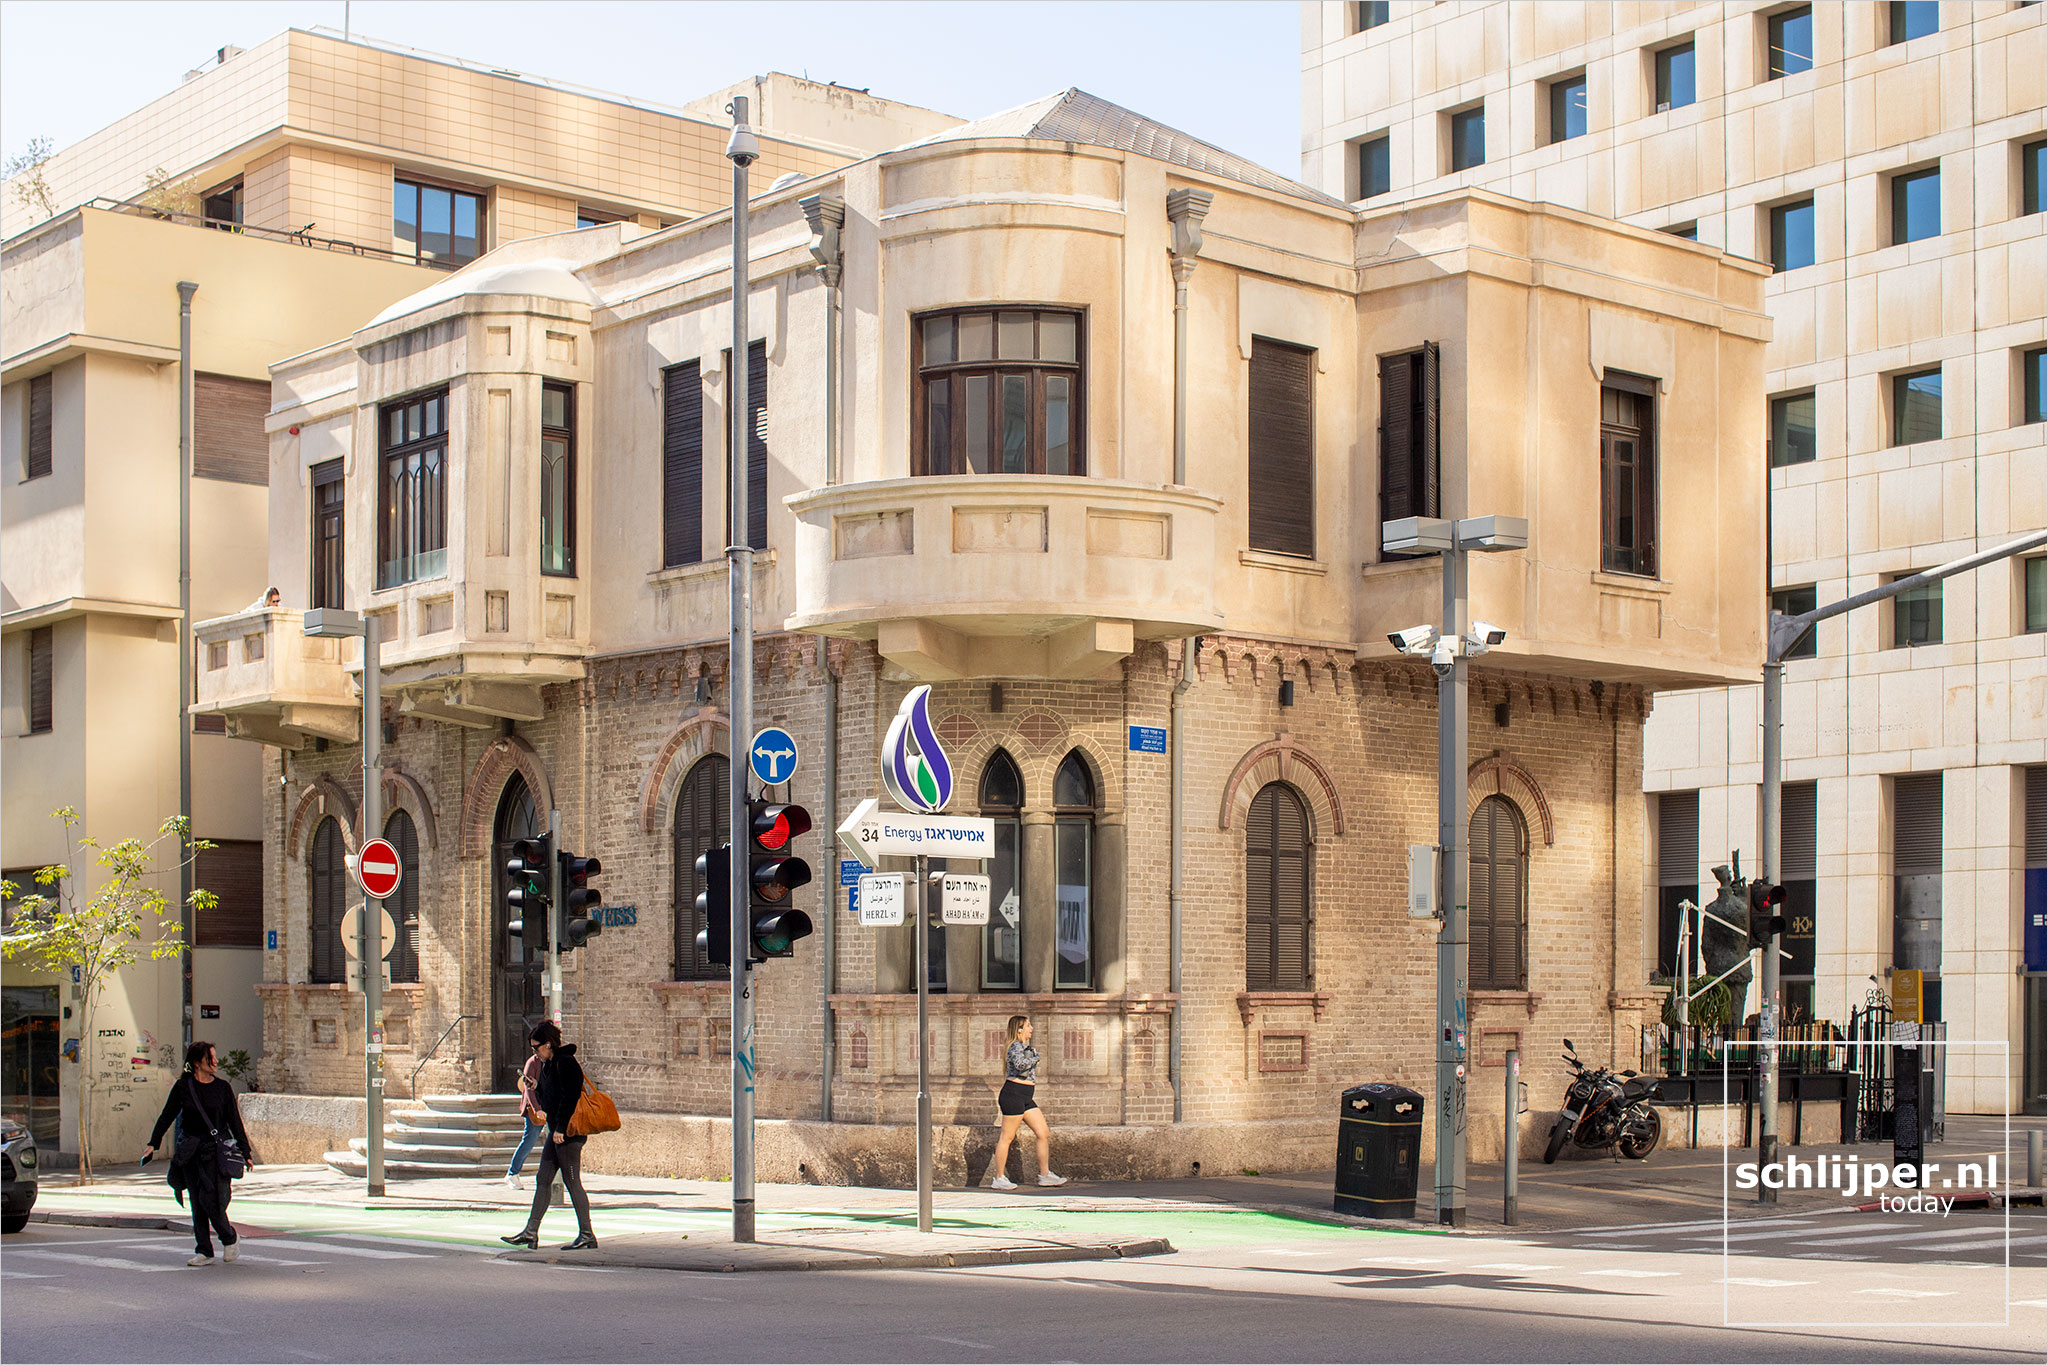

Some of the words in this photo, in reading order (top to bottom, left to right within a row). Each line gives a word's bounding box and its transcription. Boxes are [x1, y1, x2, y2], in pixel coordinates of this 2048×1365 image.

[862, 828, 879, 842] 34
[884, 825, 922, 842] Energy
[924, 827, 985, 842] אמישראגז
[875, 879, 892, 890] הרצל
[945, 881, 961, 891] העם
[963, 881, 978, 891] אחד
[591, 905, 637, 927] WEISS
[865, 910, 889, 919] HERZL
[945, 910, 961, 919] AHAD
[270, 935, 275, 945] 2
[742, 987, 750, 999] 6
[98, 1029, 125, 1037] ואהבת
